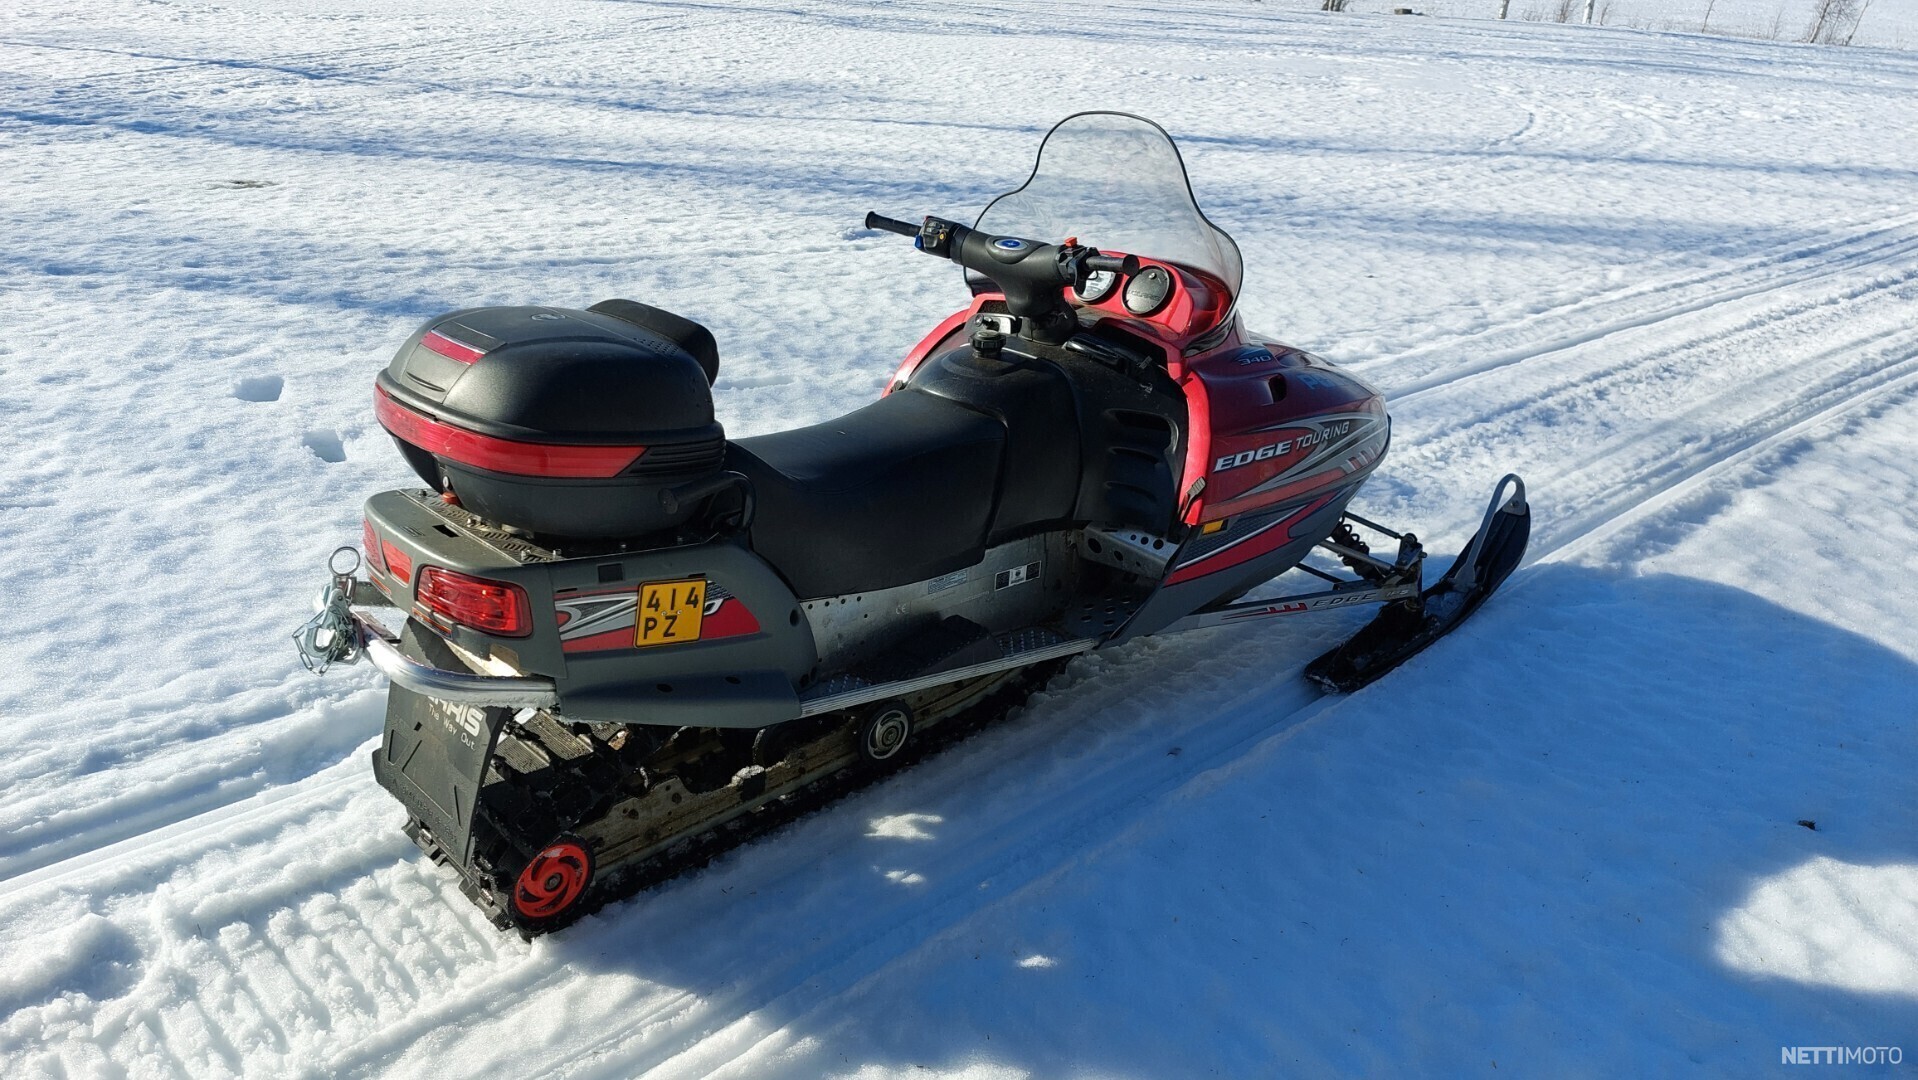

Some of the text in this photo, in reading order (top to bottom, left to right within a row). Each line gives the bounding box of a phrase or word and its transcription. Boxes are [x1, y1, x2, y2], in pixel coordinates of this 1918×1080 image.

[1238, 355, 1271, 366] 340
[1213, 421, 1350, 473] EDGE TOURING
[646, 587, 700, 612] 414
[1312, 592, 1377, 608] EDGE
[643, 615, 678, 640] PZ
[428, 696, 484, 737] ARIS
[429, 703, 476, 751] The Way Out
